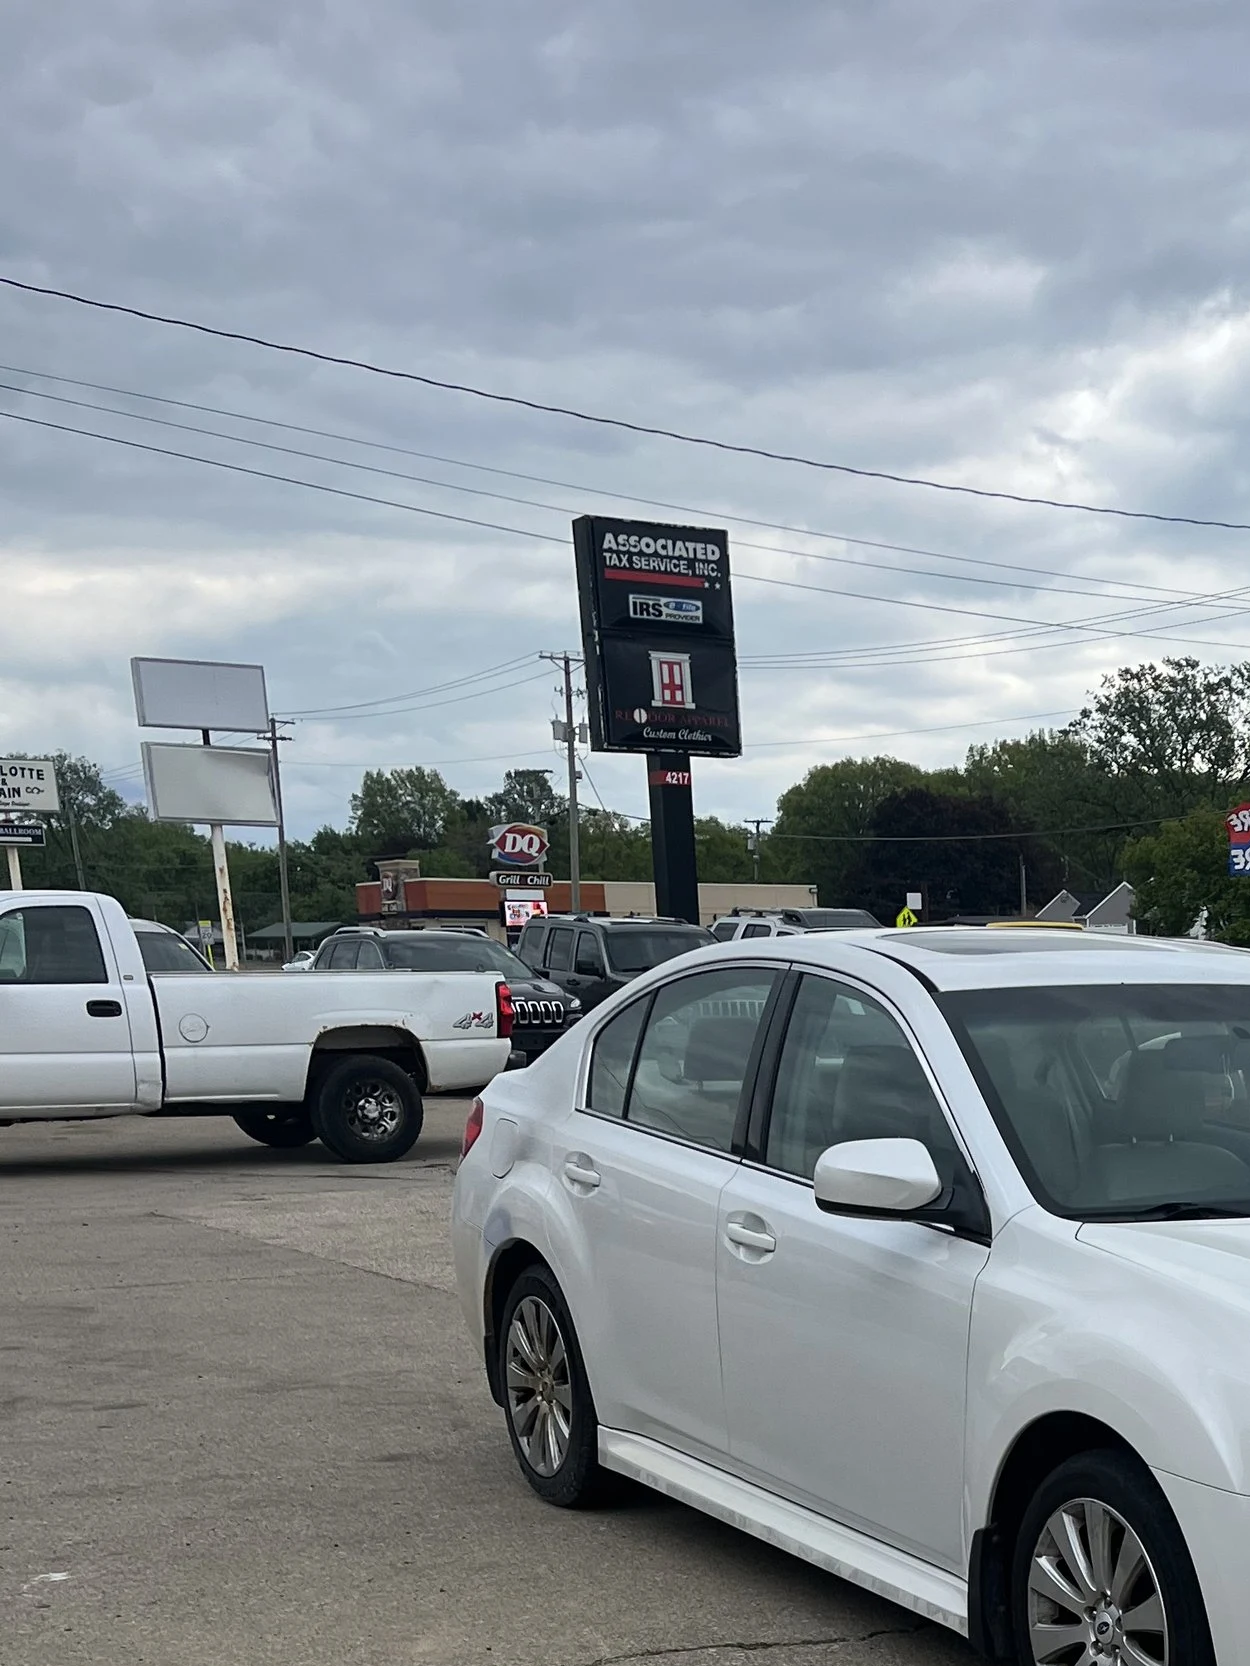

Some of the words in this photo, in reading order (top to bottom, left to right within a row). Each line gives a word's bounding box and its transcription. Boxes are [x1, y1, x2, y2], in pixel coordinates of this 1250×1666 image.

[602, 532, 720, 561] ASSOCIATED
[603, 552, 629, 568] TAX
[632, 556, 692, 576] SERVICE,
[695, 562, 721, 577] INC.
[632, 600, 663, 618] IRS
[665, 612, 700, 622] PROVIDER
[643, 727, 676, 740] Custom
[678, 728, 712, 742] Clothier
[665, 771, 690, 785] 4217
[505, 832, 541, 858] DQ
[499, 875, 520, 885] Grill
[527, 876, 550, 887] Chill
